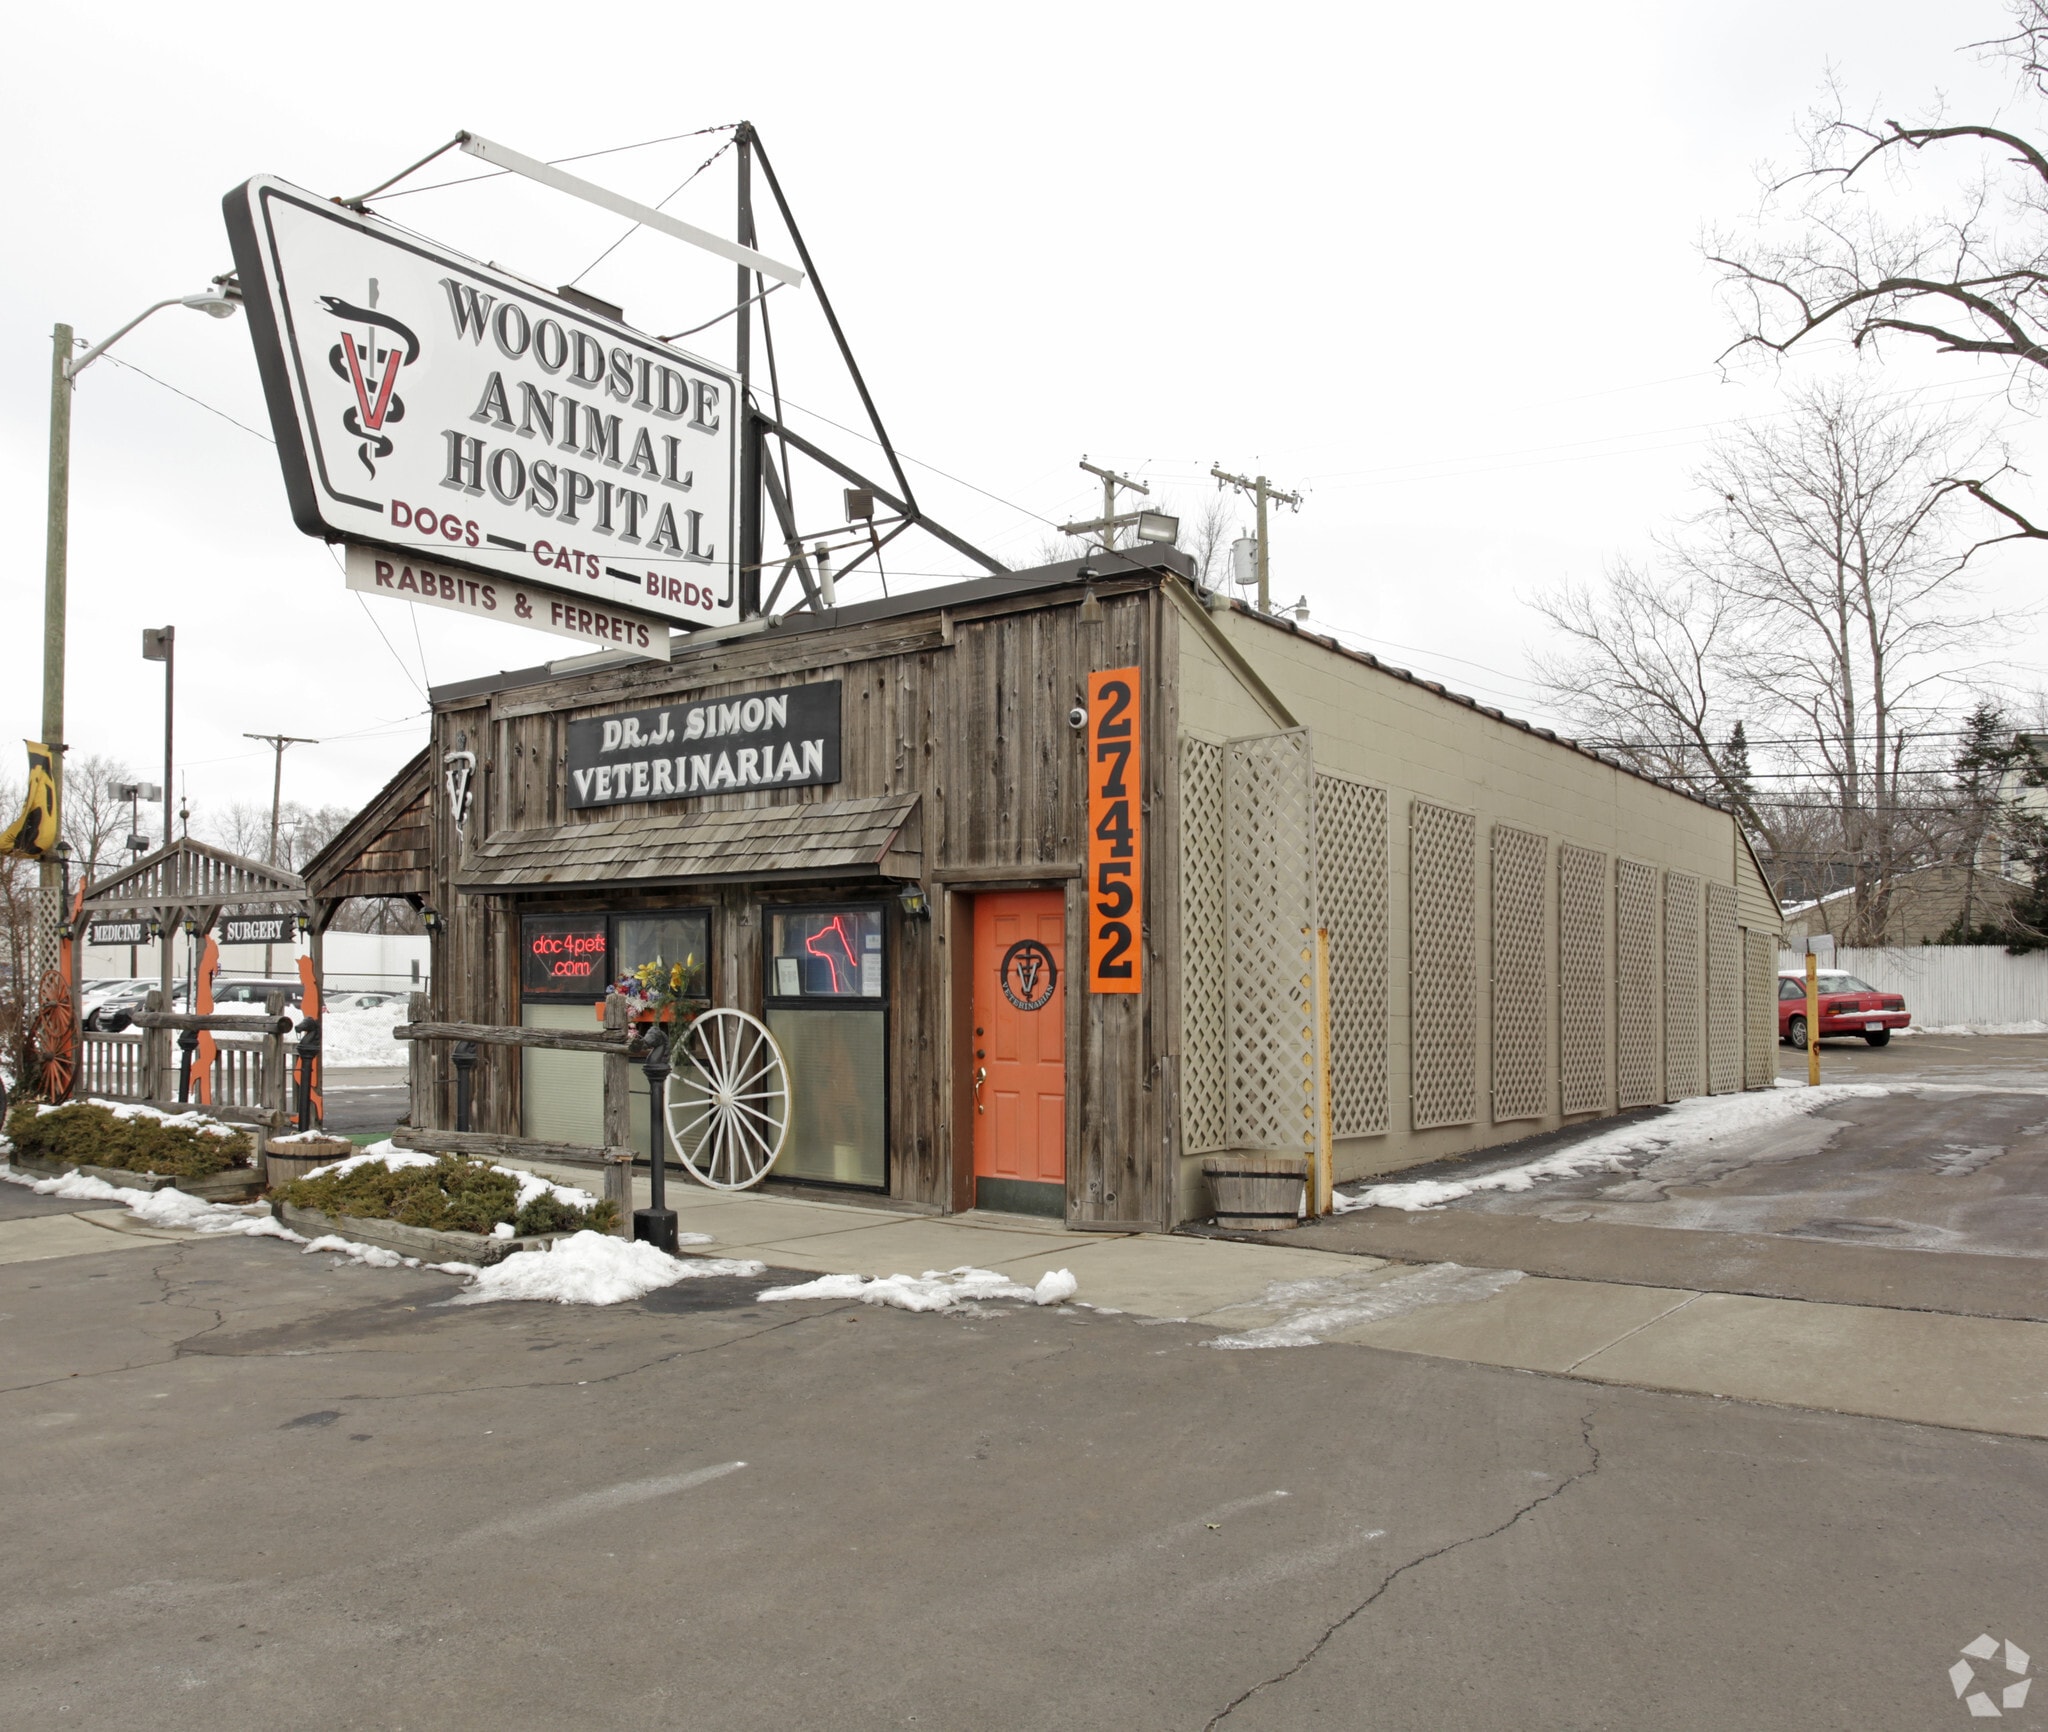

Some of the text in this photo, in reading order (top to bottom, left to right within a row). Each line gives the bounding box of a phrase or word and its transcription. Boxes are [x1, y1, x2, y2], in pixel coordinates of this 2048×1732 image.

[438, 277, 720, 436] WOODSIDE
[468, 371, 693, 493] ANIMAL
[439, 429, 715, 566] HOSPITAL
[391, 499, 714, 611] DOGS CATS BIRDS
[375, 560, 650, 648] RABBITS & FERRETS
[682, 694, 788, 742] SIMON
[573, 739, 824, 804] VETERINARIAN
[1096, 680, 1133, 979] 27452
[93, 923, 141, 942] MEDICINE
[227, 920, 283, 941] SURGERY
[1002, 981, 1054, 1011] VETERINARIAN
